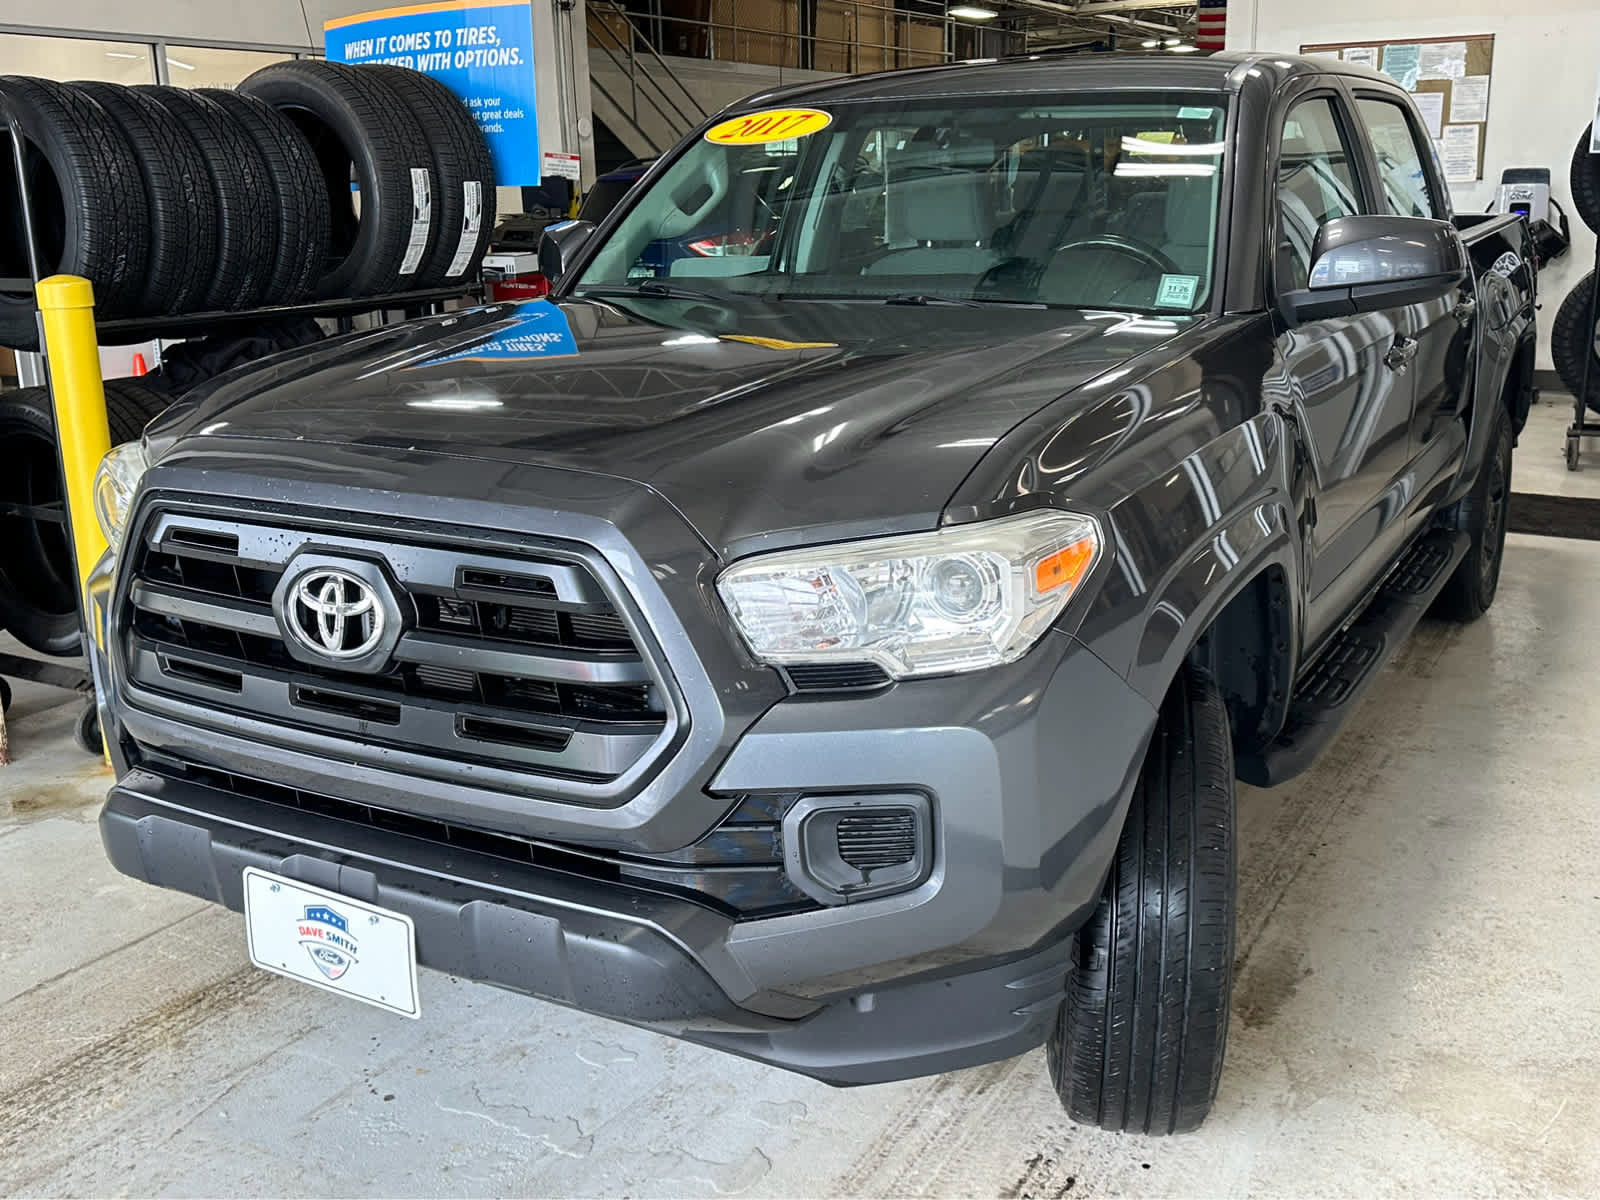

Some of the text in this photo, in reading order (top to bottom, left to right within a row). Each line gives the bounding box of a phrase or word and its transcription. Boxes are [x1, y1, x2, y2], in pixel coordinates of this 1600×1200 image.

[344, 25, 501, 60] WHEN IT COMES TO TIRES,
[417, 52, 452, 73] WITH
[454, 47, 524, 69] OPTIONS.
[469, 96, 483, 107] ask
[484, 97, 501, 109] your
[481, 109, 502, 122] great
[503, 108, 524, 119] deals
[717, 114, 816, 139] 2017
[299, 926, 358, 954] DAVE SMITH
